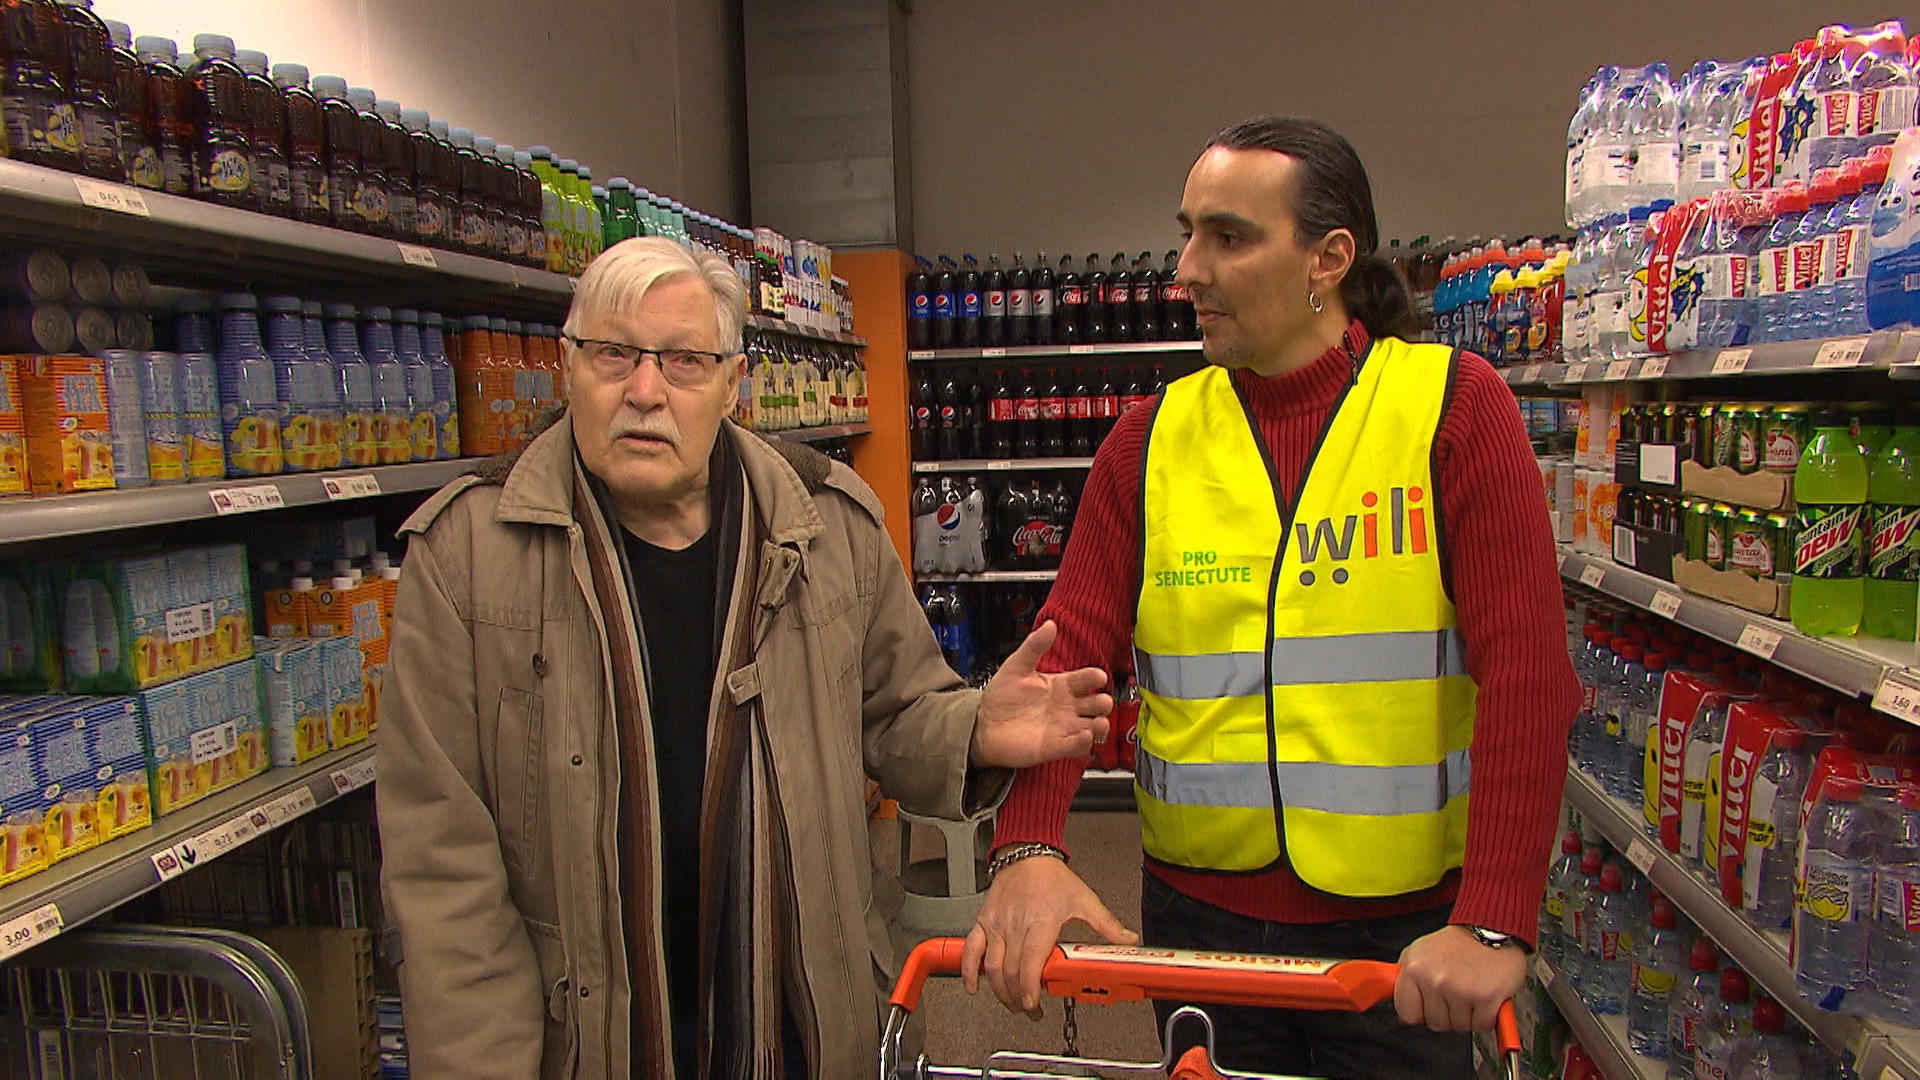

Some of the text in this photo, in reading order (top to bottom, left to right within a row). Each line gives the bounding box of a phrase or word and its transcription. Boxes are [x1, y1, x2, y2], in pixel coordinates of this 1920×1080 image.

[1295, 486, 1429, 563] wili
[1182, 551, 1218, 566] PRO
[1154, 566, 1251, 586] SENECTUTE
